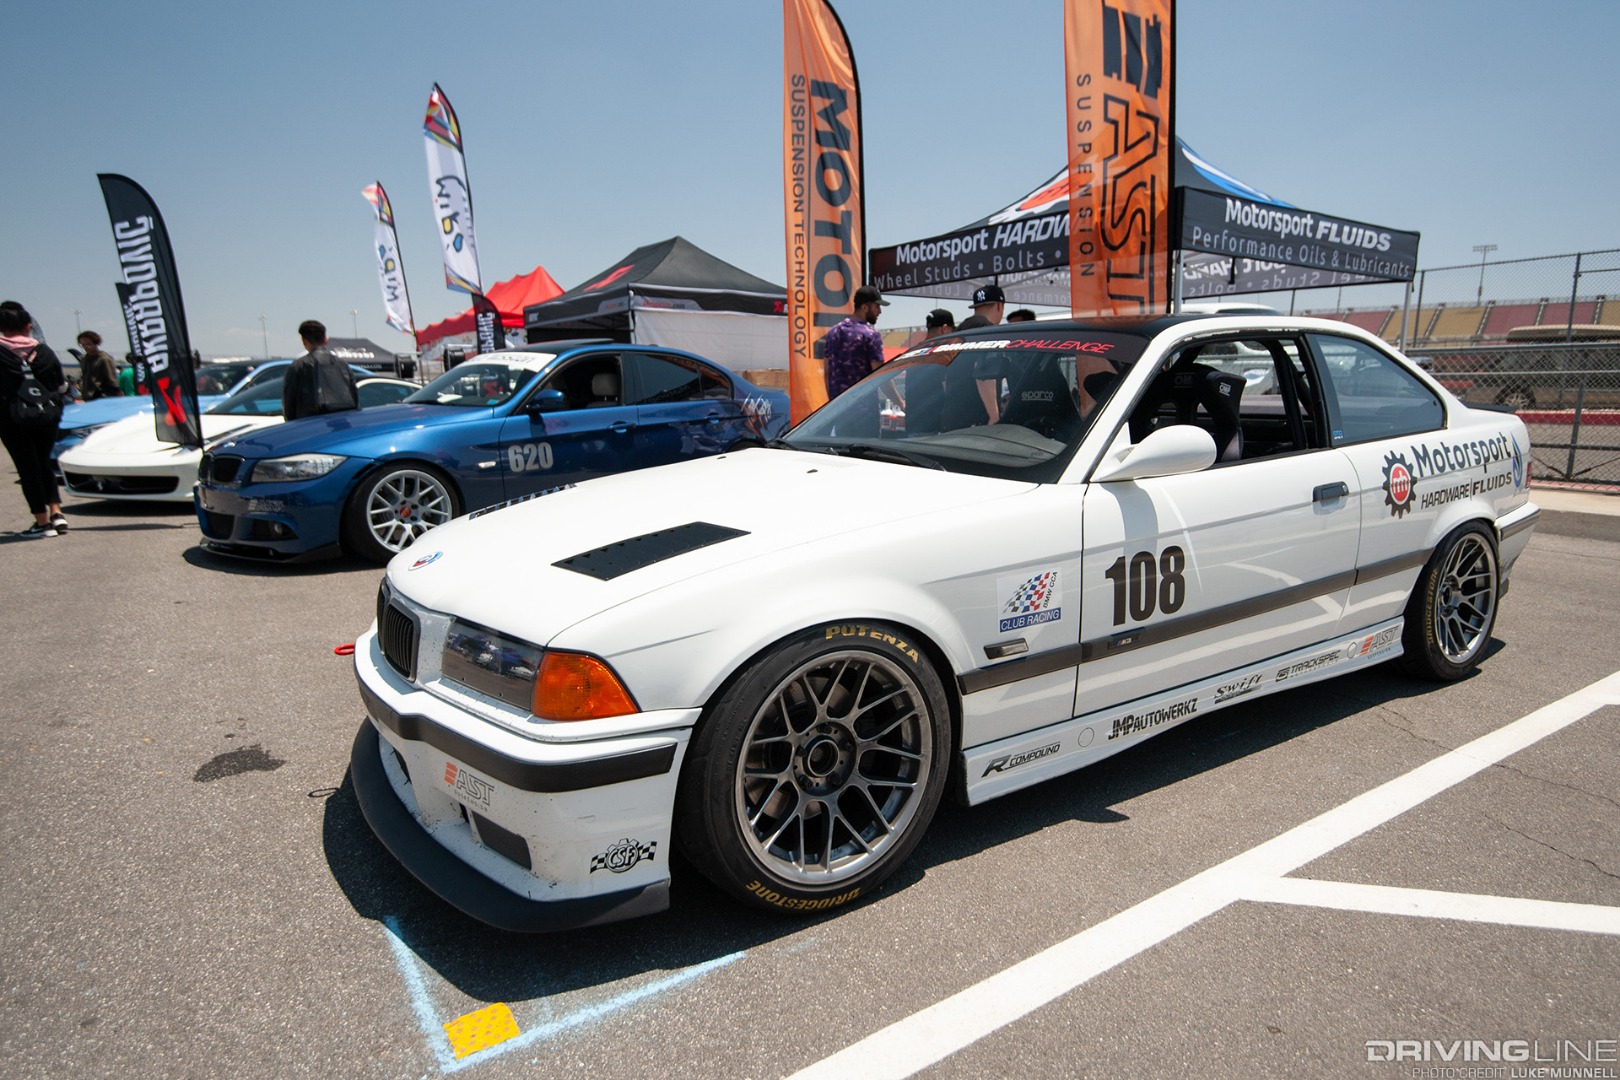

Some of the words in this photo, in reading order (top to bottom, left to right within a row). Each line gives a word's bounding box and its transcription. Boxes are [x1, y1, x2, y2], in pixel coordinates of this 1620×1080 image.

[791, 74, 805, 213] SUSPENSION
[1077, 73, 1095, 277] SUSPENSION
[1225, 198, 1313, 239] Motorsport
[1315, 220, 1392, 252] FLUIDS
[896, 229, 989, 267] Motorsport
[1192, 226, 1293, 261] Performance
[1299, 245, 1326, 266] Oils
[1331, 252, 1340, 267] &
[1345, 253, 1409, 278] Lubricants
[794, 219, 807, 357] TECHNOLOGY
[873, 273, 918, 291] Wheel
[924, 261, 971, 283] Studs
[993, 250, 1044, 273] Bolts
[508, 442, 554, 473] 620
[1411, 432, 1511, 478] Motorsport
[1050, 571, 1058, 588] CCA
[1105, 545, 1186, 626] 108
[1001, 616, 1025, 631] CLUB
[1027, 609, 1060, 625] RACING
[825, 625, 919, 664] POTENZA
[1010, 743, 1061, 767] COMPOUND
[608, 847, 634, 868] CSF
